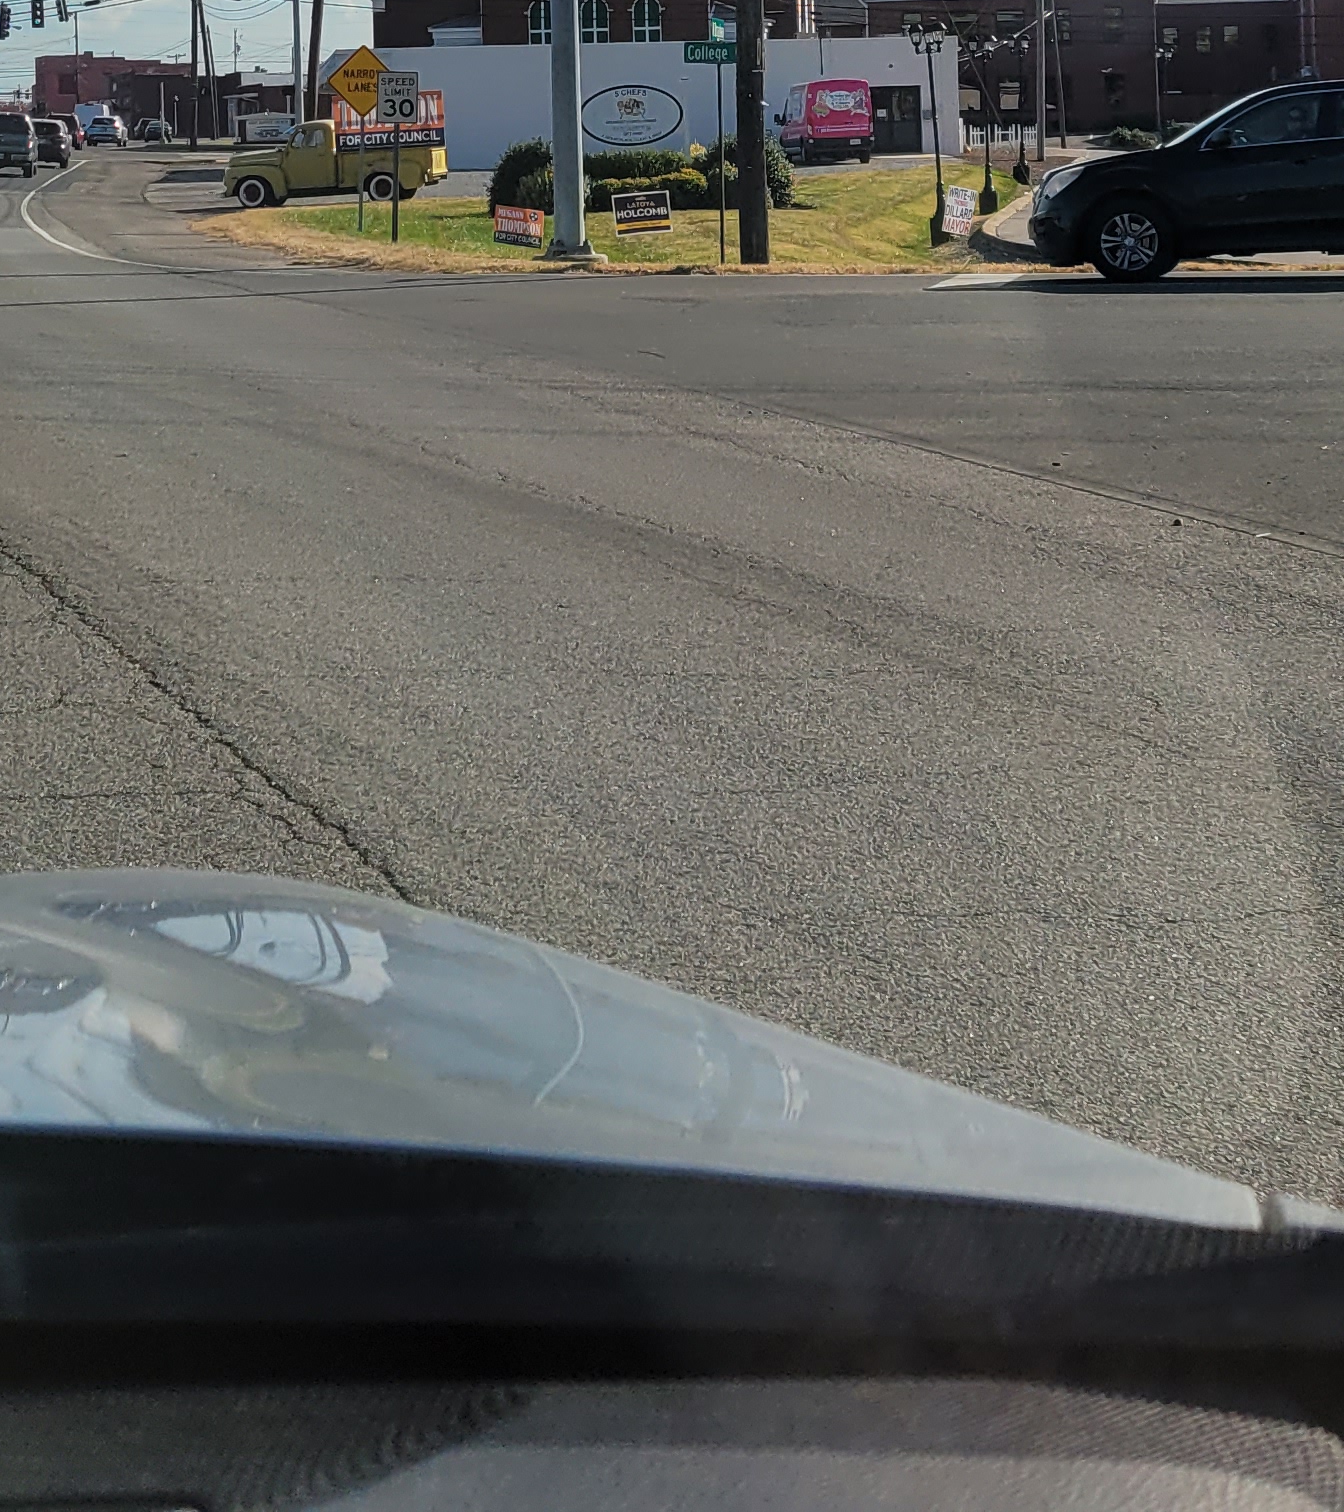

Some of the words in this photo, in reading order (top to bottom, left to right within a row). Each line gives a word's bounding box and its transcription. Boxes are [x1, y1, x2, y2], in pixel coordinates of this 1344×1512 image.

[687, 45, 729, 62] College
[343, 69, 378, 79] NARRO
[347, 81, 377, 93] LANES
[380, 77, 415, 86] SPEED
[384, 88, 411, 96] LIMIT
[383, 99, 415, 118] 30
[340, 135, 361, 147] FOR
[364, 133, 389, 146] CITY
[390, 129, 441, 143] COUNCIL
[626, 200, 655, 208] LATOYA
[616, 206, 668, 219] HOLCOMB
[497, 217, 542, 236] THOMPSON
[942, 217, 972, 235] MAYOR
[495, 232, 506, 240] FOR
[507, 233, 517, 242] CITY
